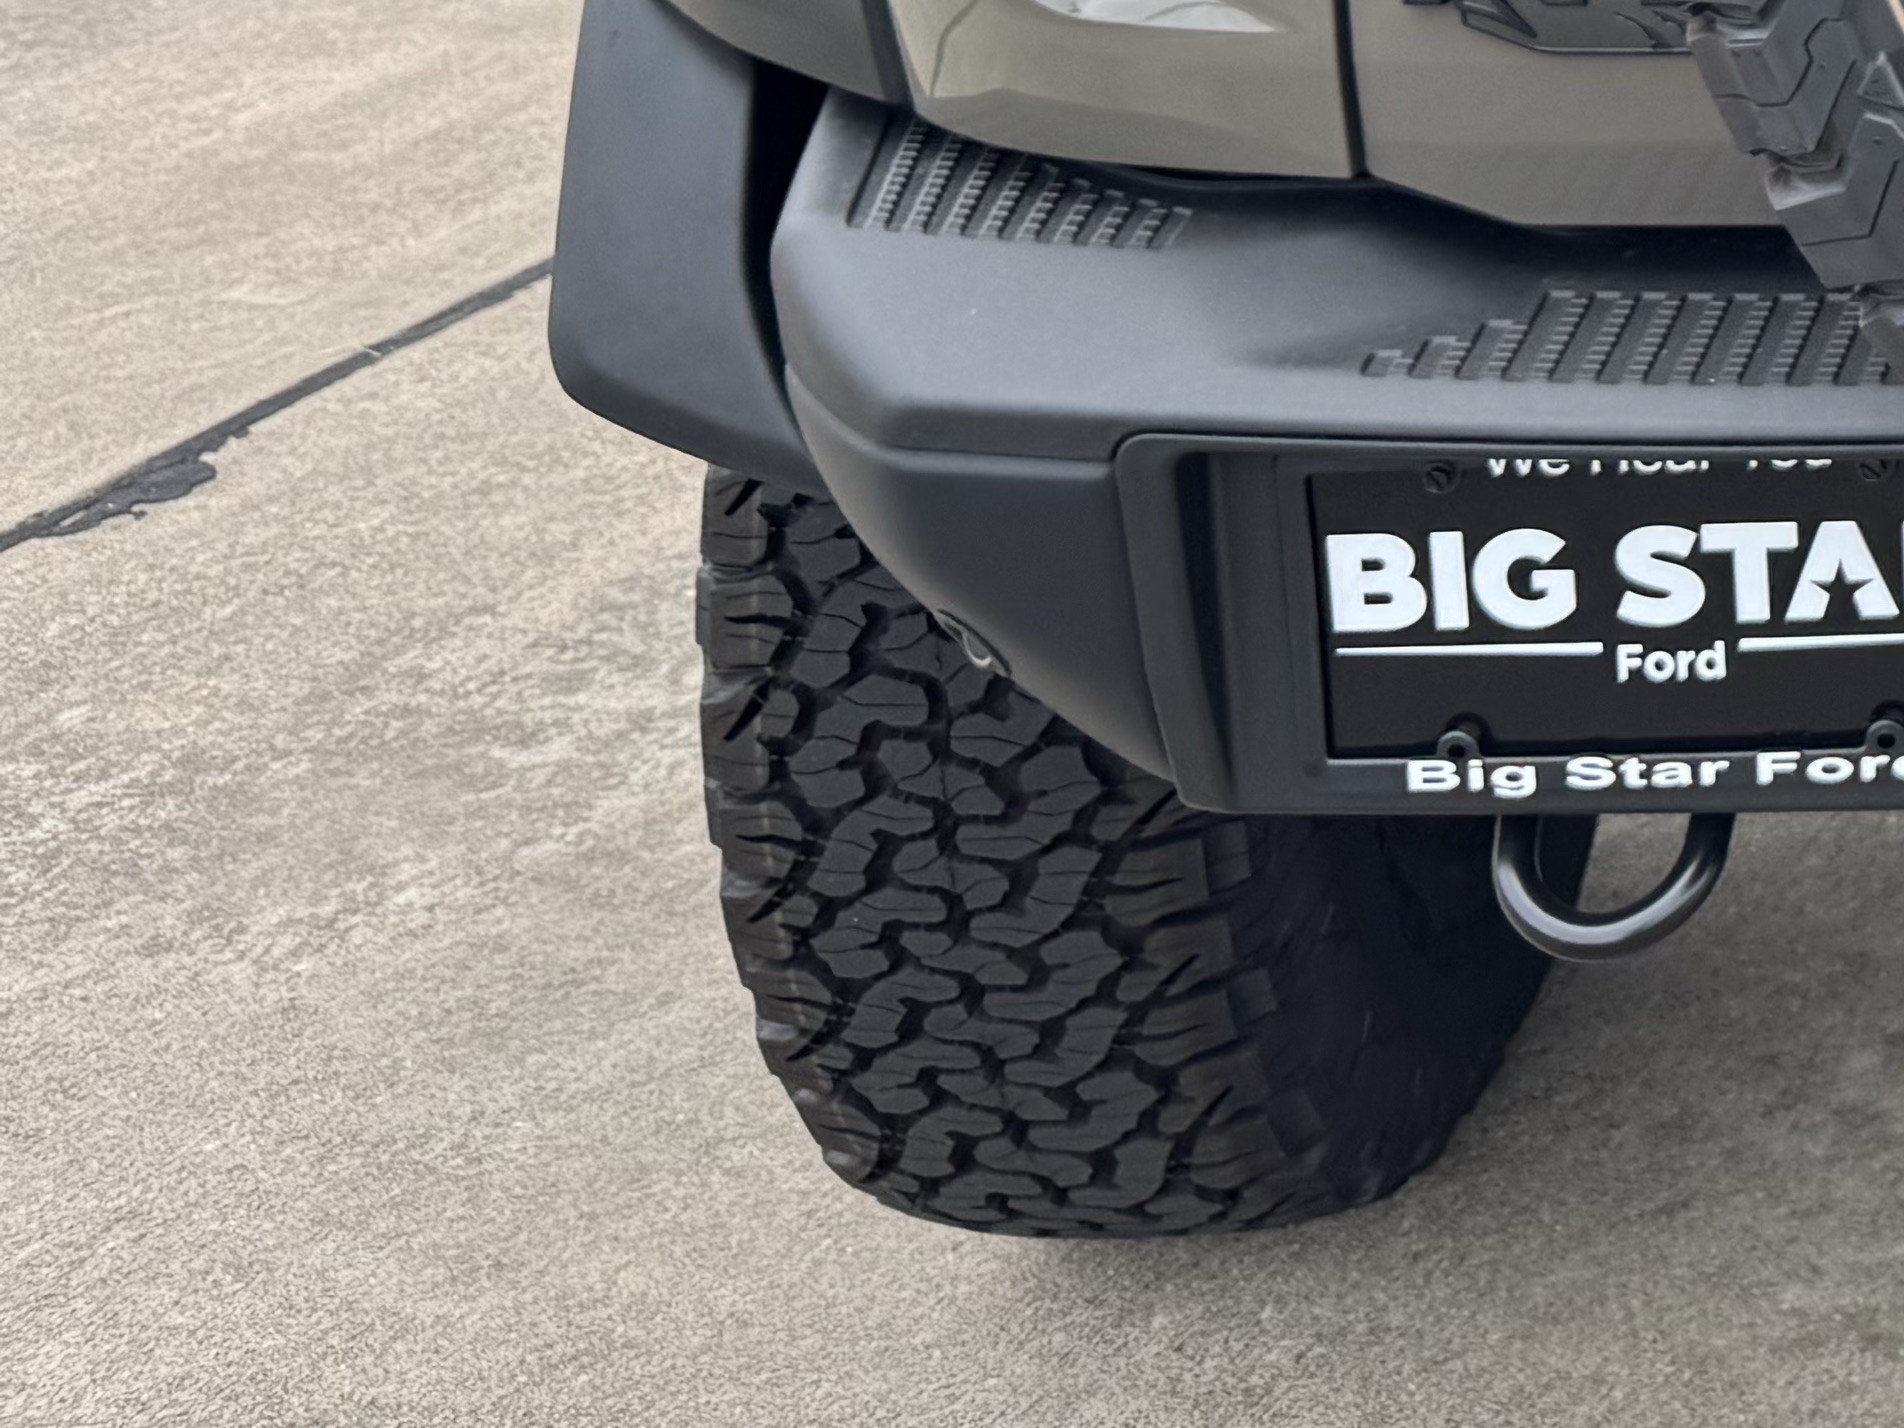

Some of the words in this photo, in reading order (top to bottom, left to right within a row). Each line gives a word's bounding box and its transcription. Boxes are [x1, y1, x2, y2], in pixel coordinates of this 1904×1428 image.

[1325, 529, 1578, 634] BIG
[1615, 640, 1728, 684] Ford
[1406, 755, 1538, 799] Big
[1565, 752, 1730, 791] Star
